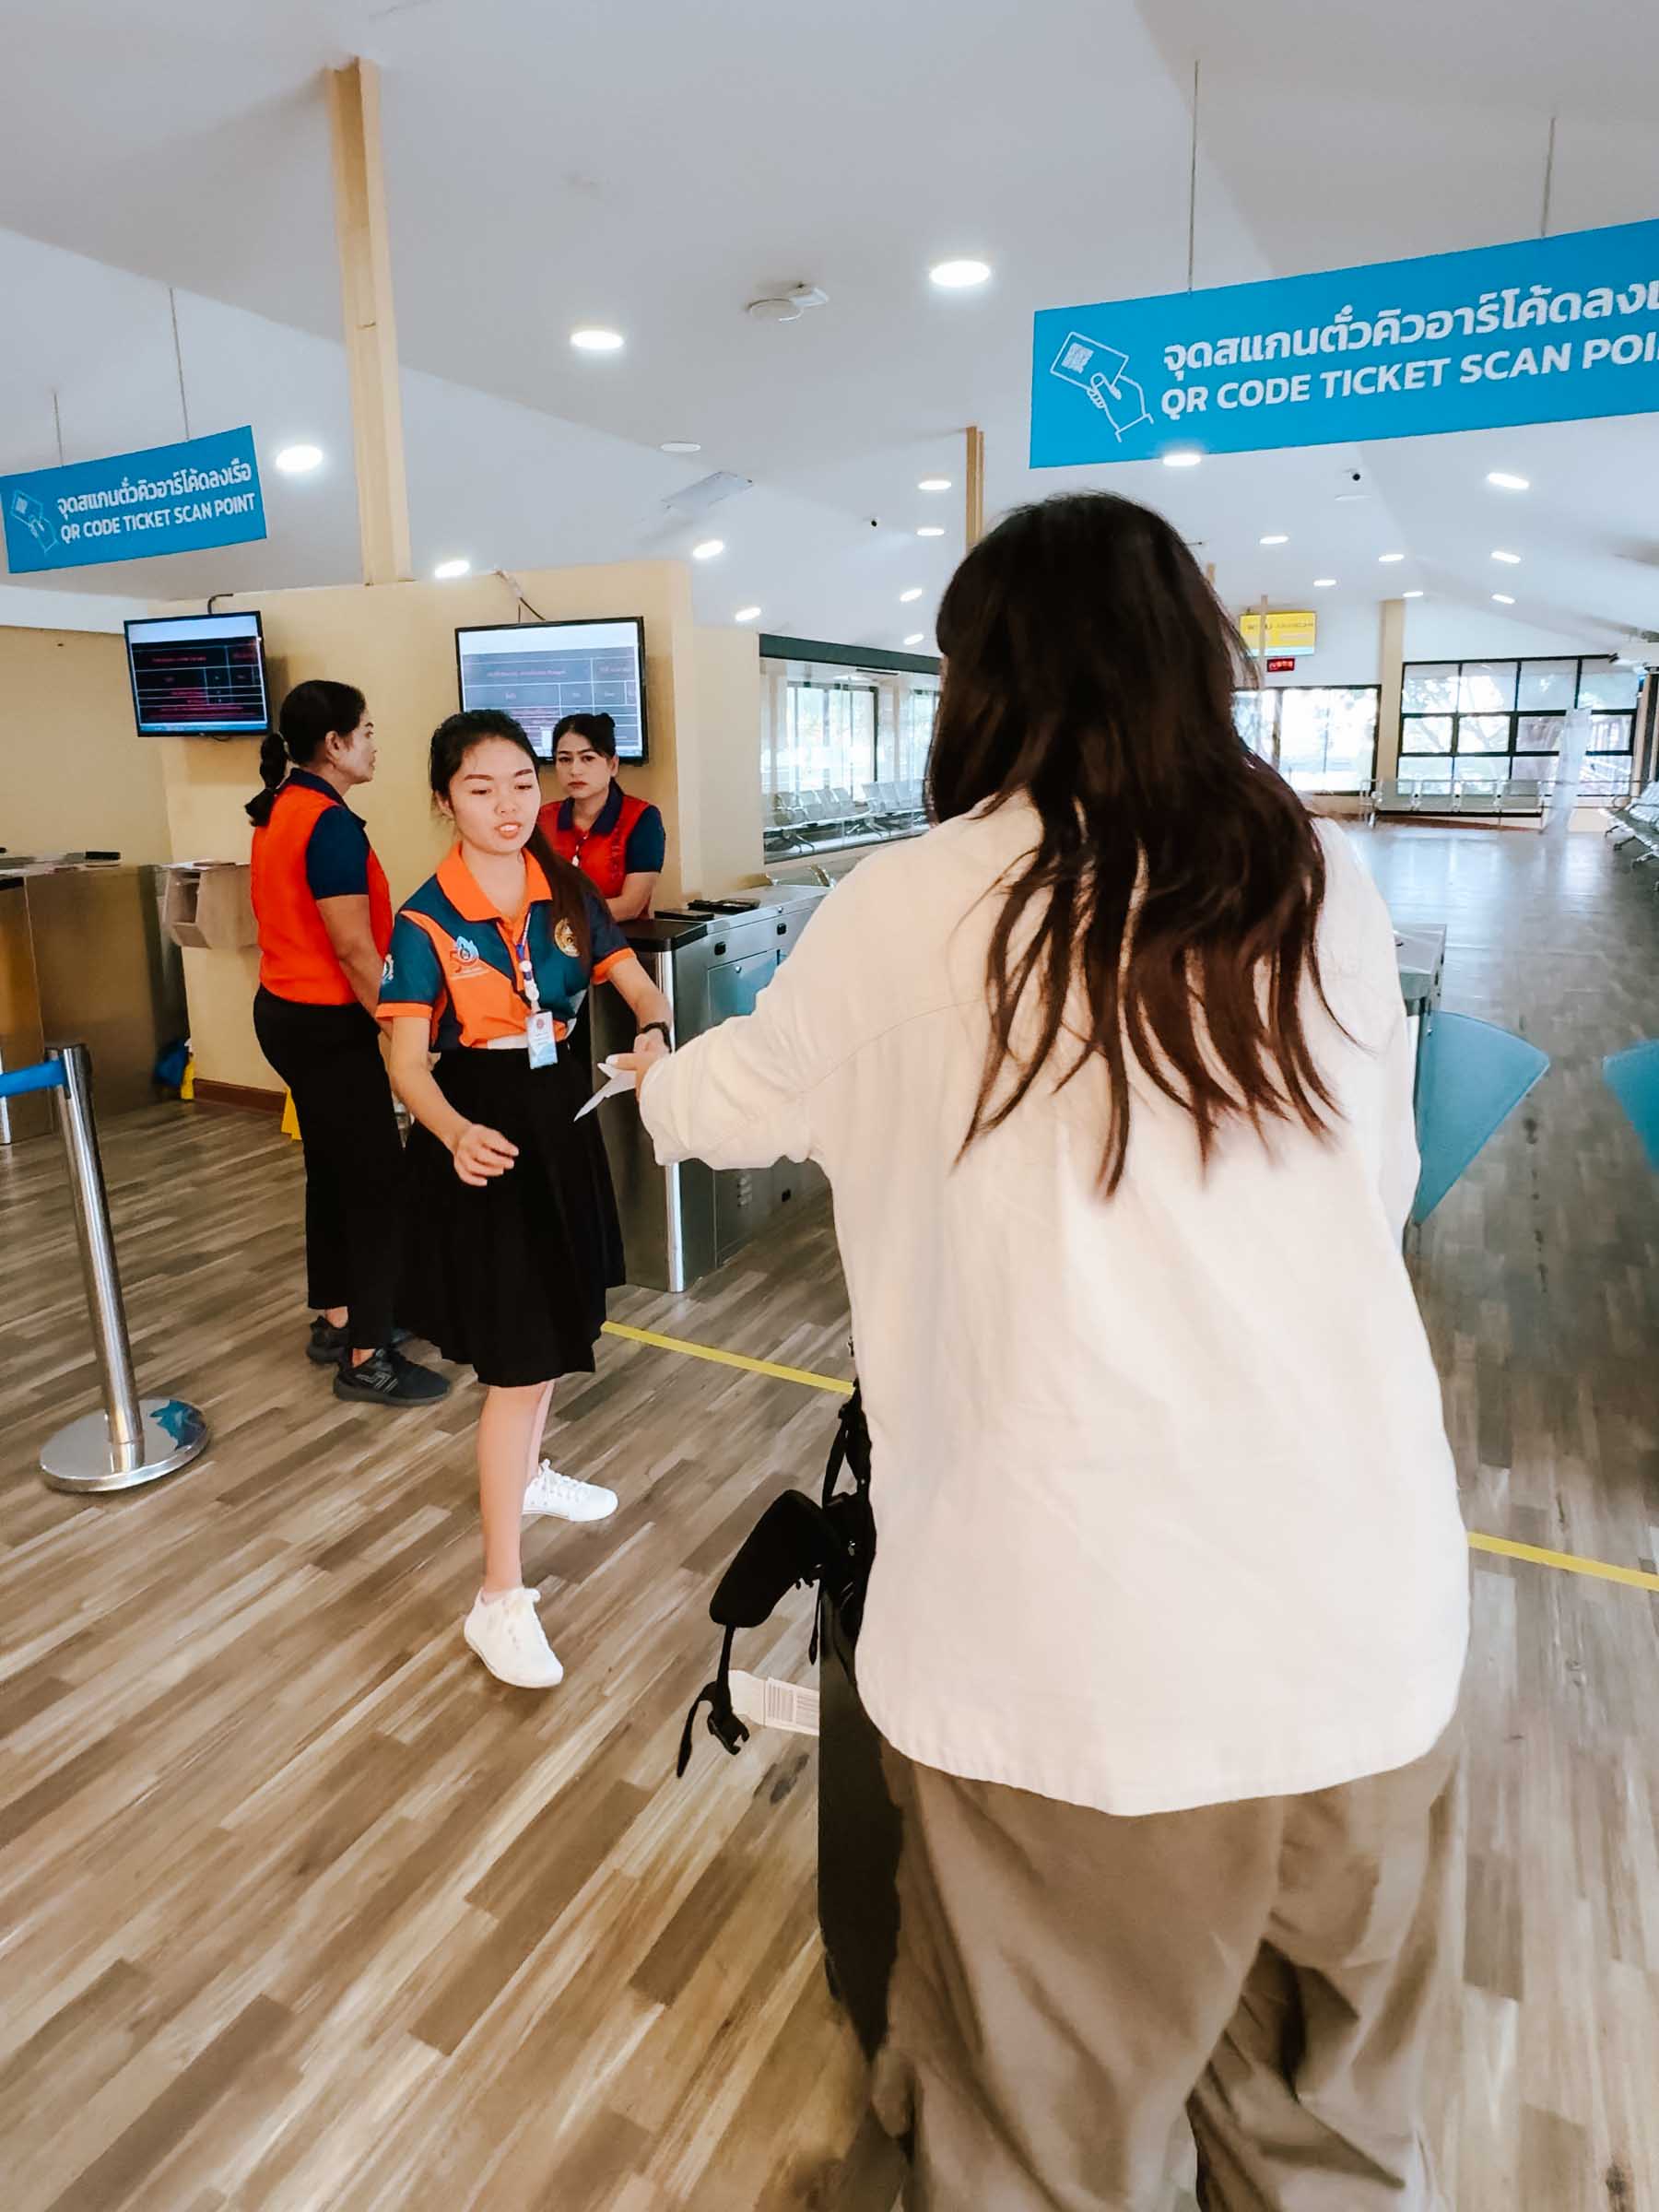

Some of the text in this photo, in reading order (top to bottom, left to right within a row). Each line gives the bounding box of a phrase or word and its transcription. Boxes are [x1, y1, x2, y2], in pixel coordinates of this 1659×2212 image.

[1160, 330, 1659, 420] QR CODE TICKET SCAN POI
[60, 492, 256, 545] QR CODE TICKET SCAN POINT
